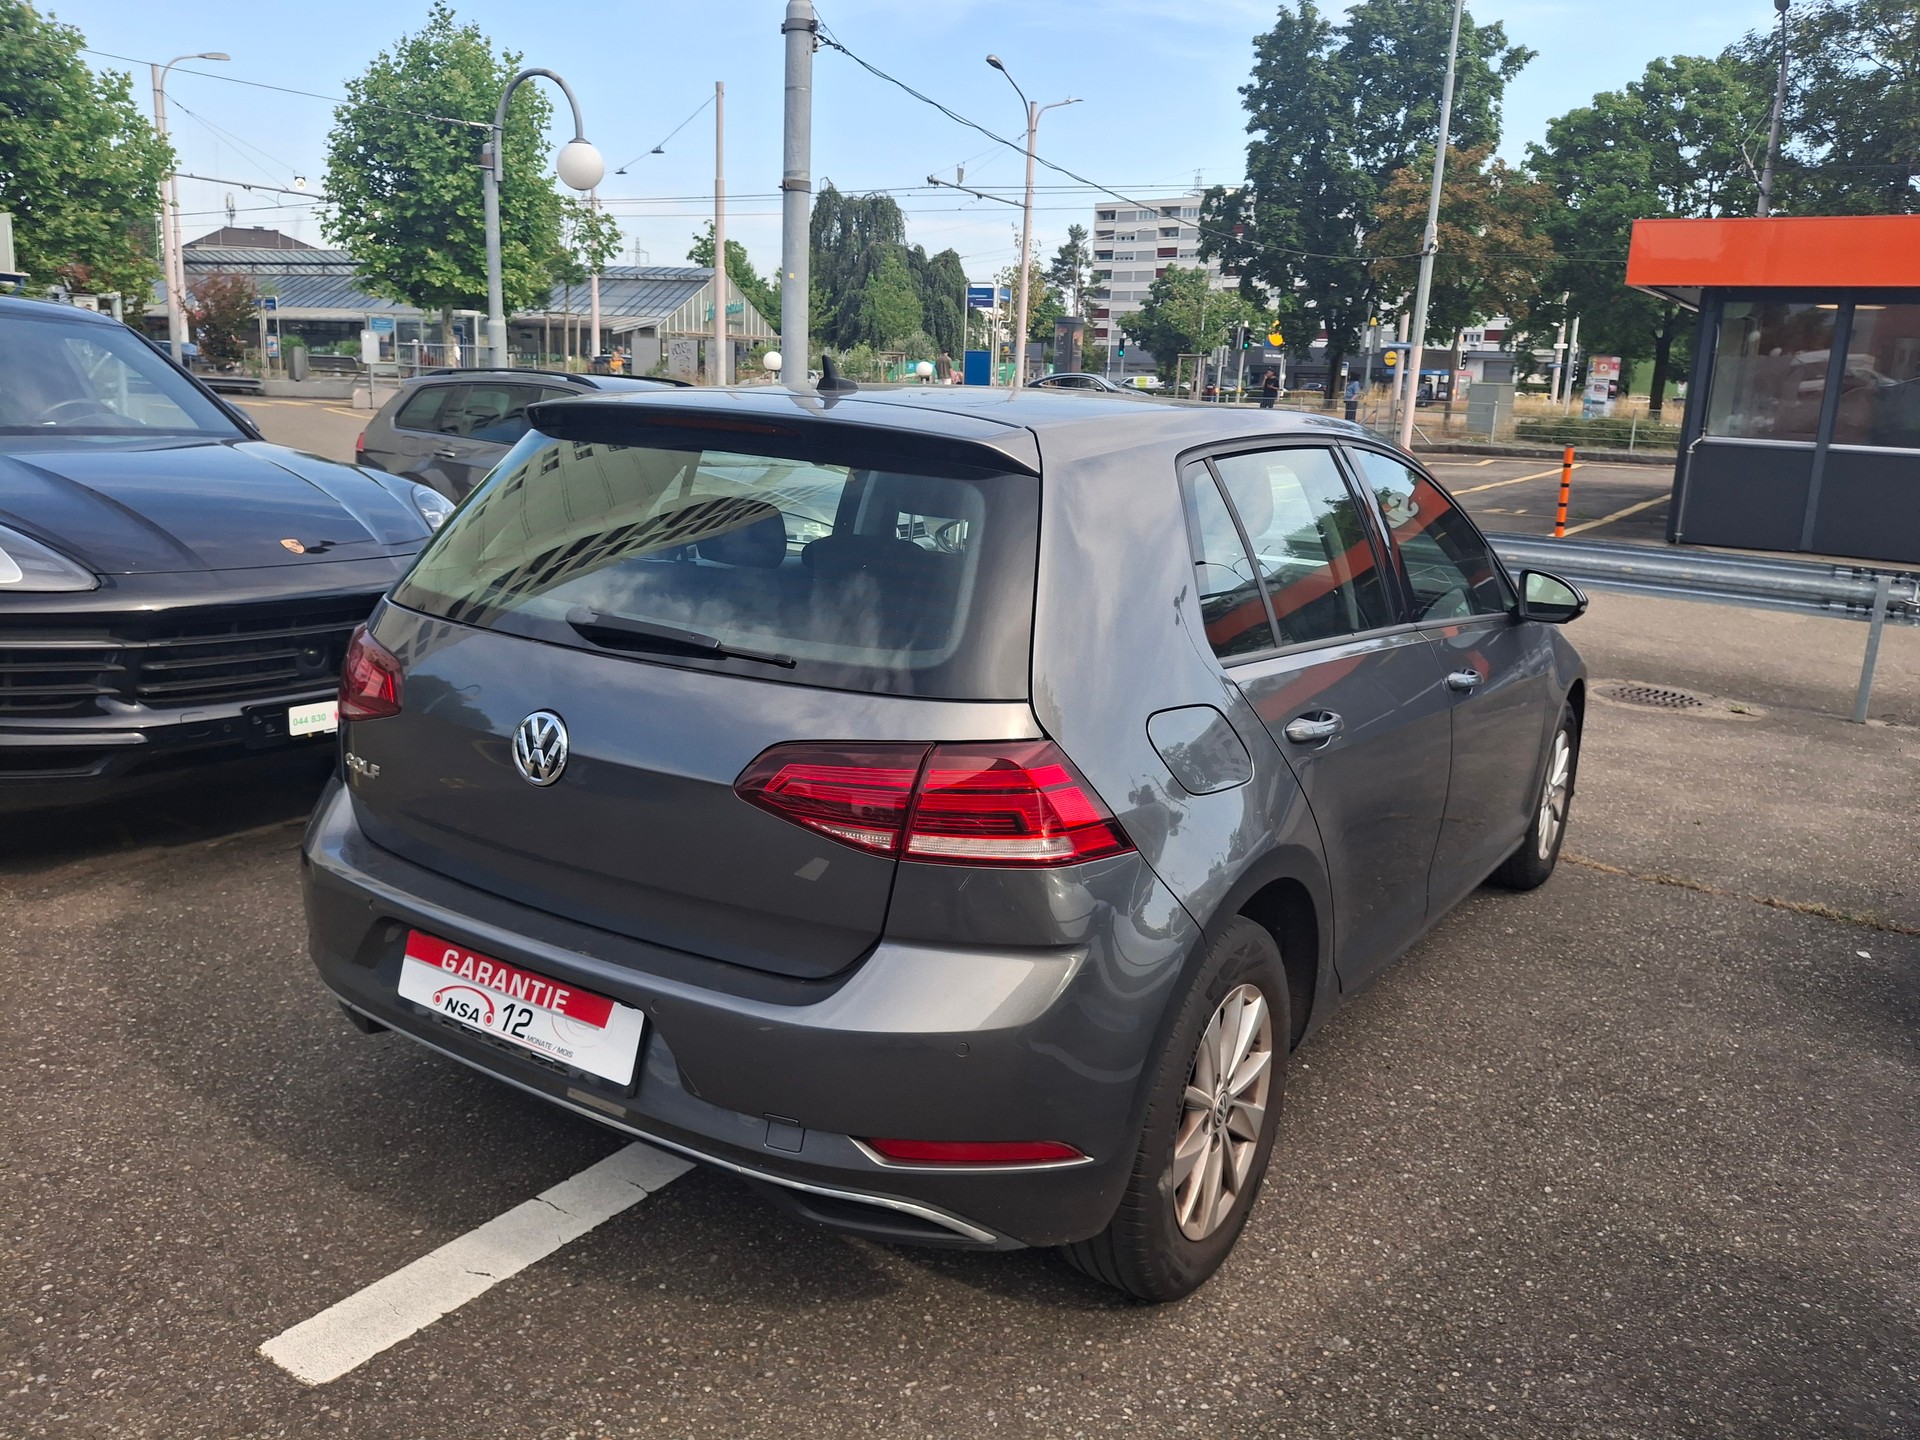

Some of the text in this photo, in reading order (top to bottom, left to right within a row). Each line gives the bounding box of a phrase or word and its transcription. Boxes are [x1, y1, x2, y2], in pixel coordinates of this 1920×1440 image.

[293, 713, 326, 726] 044 830
[441, 949, 570, 1014] GARANTIE
[444, 997, 480, 1023] NSA
[502, 1003, 534, 1039] 12
[526, 1035, 552, 1049] MONATE
[557, 1047, 573, 1058] MOIS
